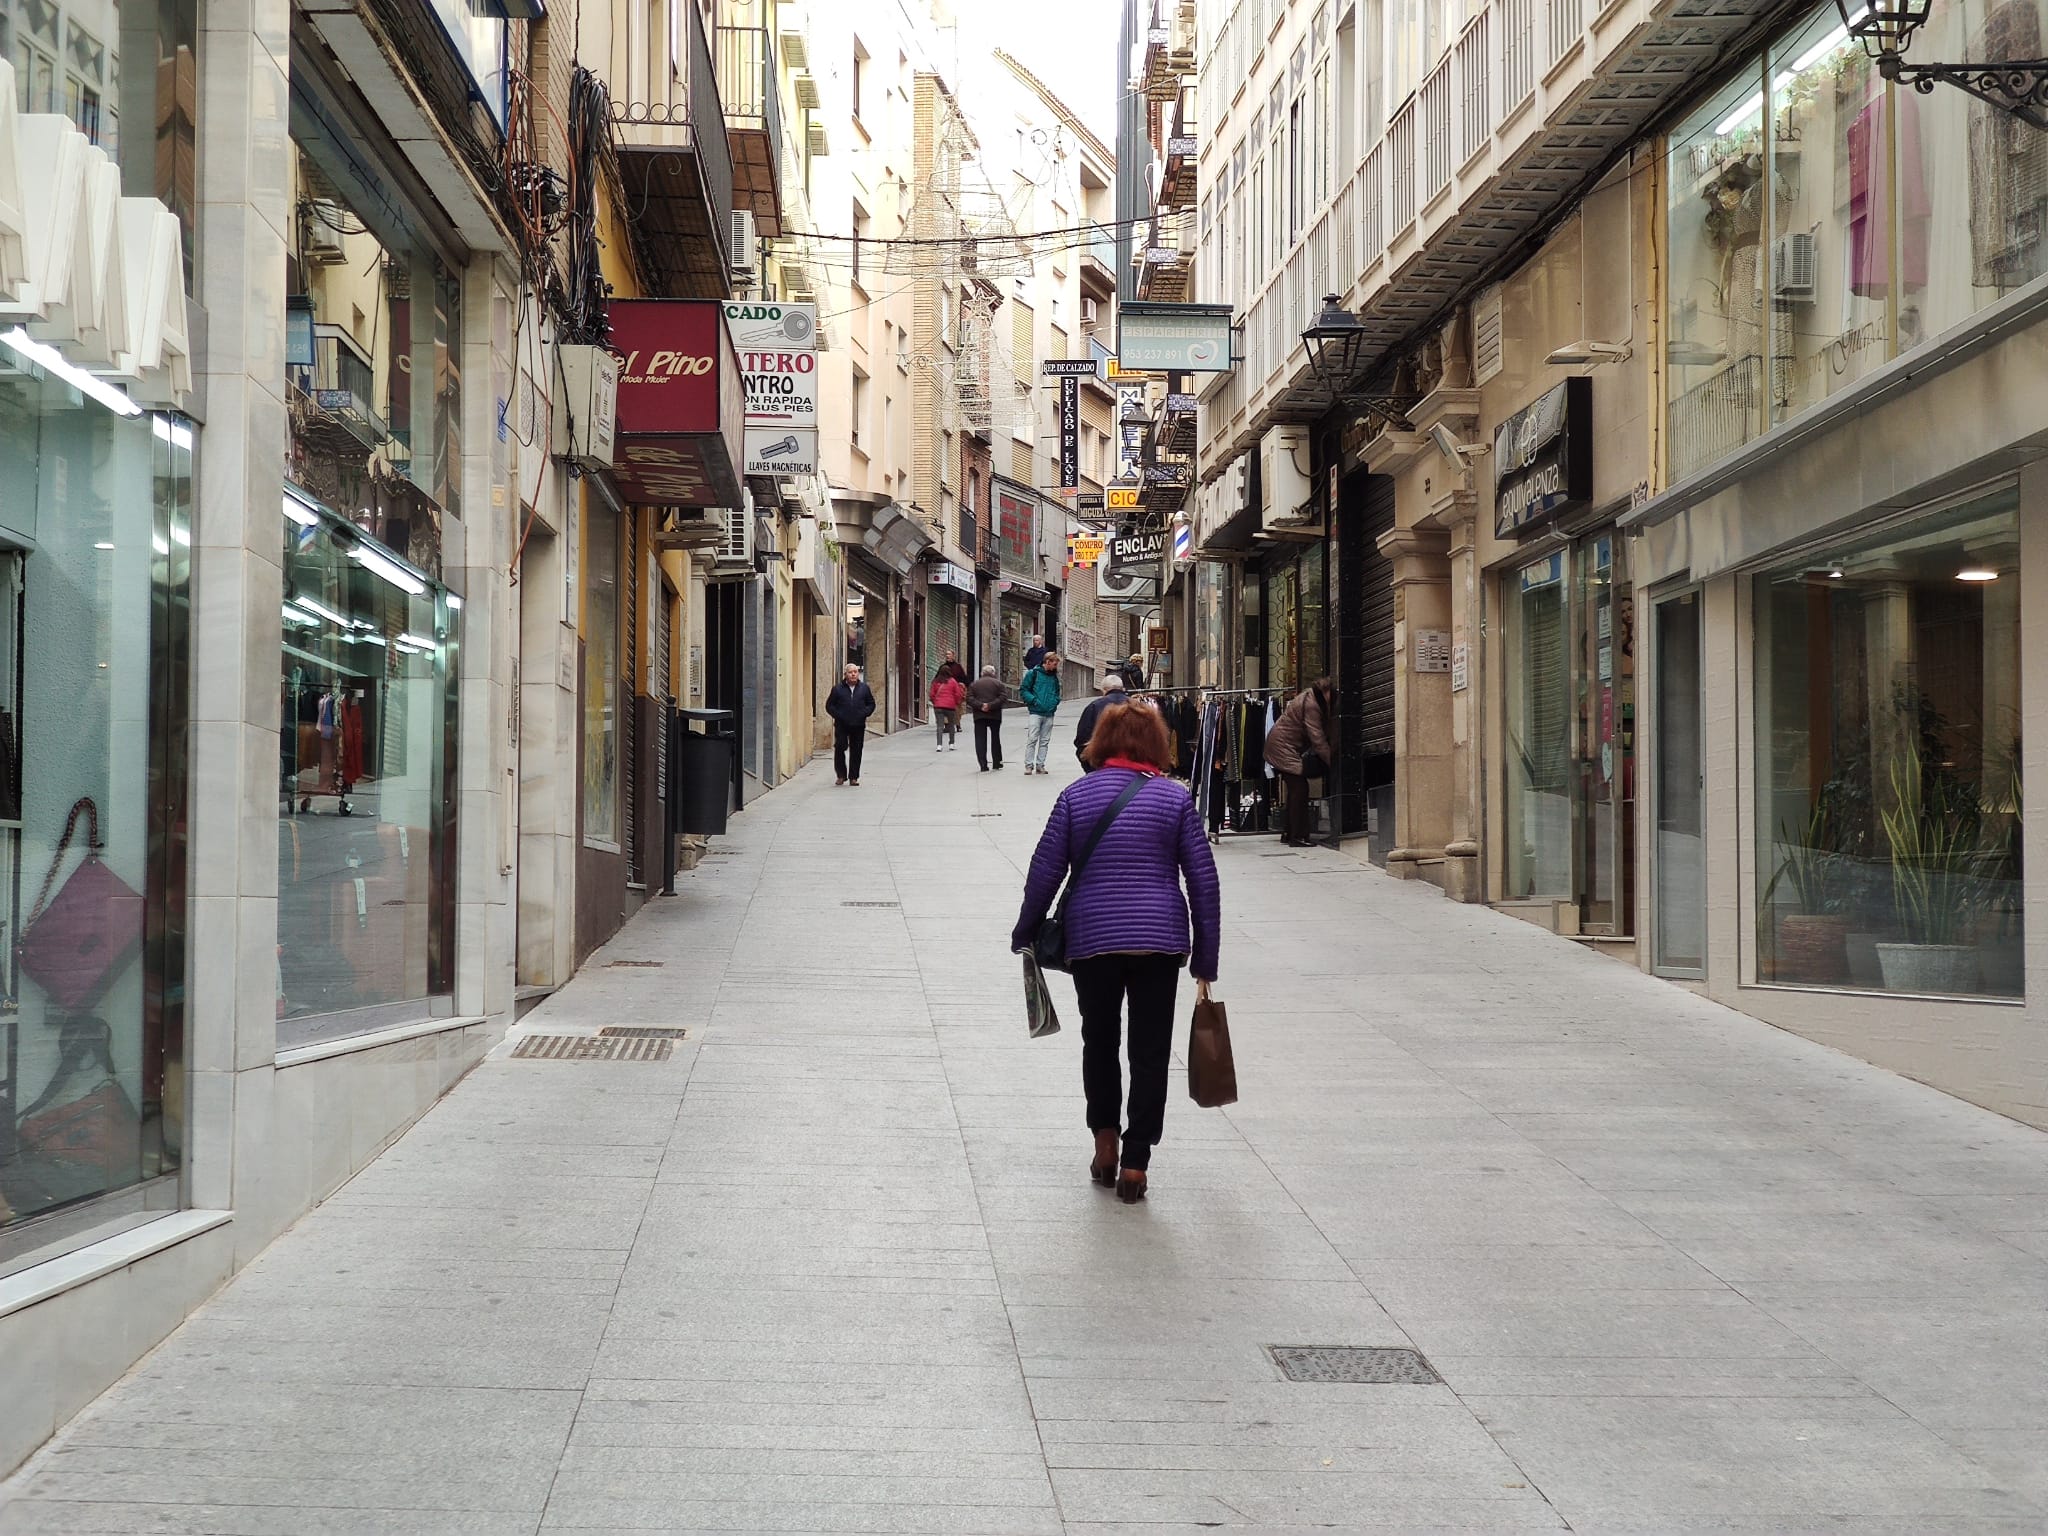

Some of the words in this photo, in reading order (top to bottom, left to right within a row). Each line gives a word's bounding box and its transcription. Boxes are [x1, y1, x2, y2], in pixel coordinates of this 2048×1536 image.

[724, 305, 782, 320] CADO
[1123, 348, 1141, 360] 953
[1144, 349, 1162, 360] 237
[1164, 350, 1182, 360] 891
[646, 351, 714, 375] Pino
[1057, 363, 1066, 372] DE
[1066, 363, 1095, 372] CALZADO
[620, 375, 642, 384] Moda
[645, 376, 671, 384] Mujer
[763, 396, 812, 405] RAPIDA
[1064, 378, 1075, 430] DUPLICADO
[752, 404, 780, 412] SUS
[784, 404, 813, 413] PIES
[1064, 435, 1074, 447] DE
[749, 461, 770, 471] LLAVES
[771, 461, 812, 473] MAGNÉTICAS
[1080, 507, 1105, 518] MIGUEL
[1074, 541, 1103, 549] COMPRO
[1074, 552, 1084, 560] ORO
[1122, 555, 1138, 563] Nuevo
[1139, 553, 1144, 561] &
